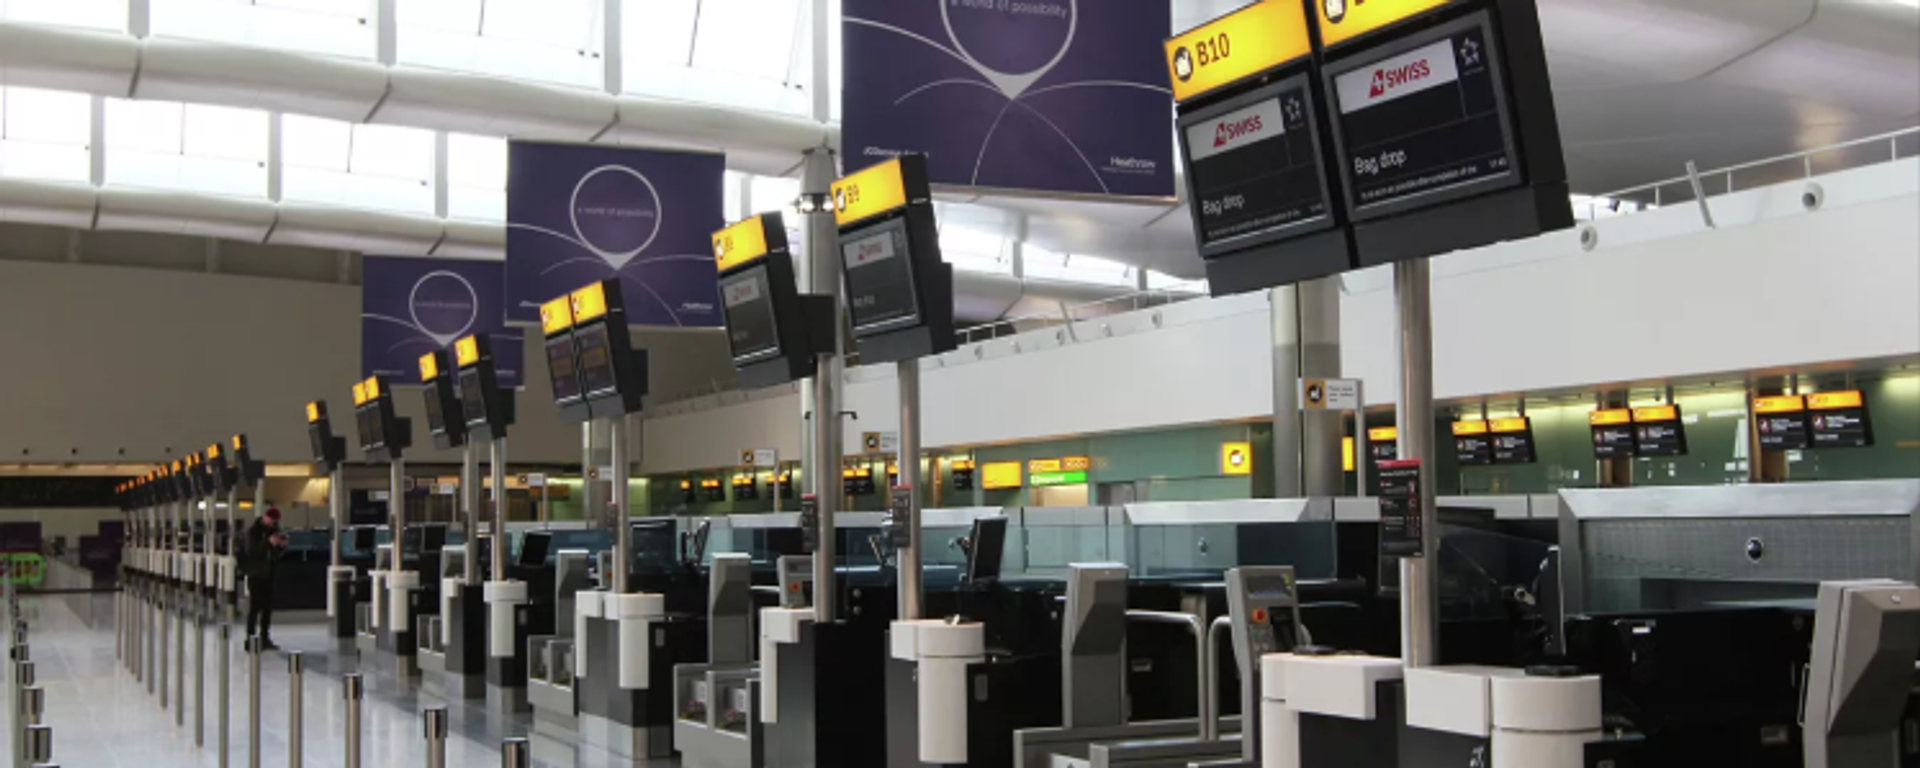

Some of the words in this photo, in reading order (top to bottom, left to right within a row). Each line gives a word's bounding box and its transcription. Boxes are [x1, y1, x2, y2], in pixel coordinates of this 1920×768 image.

[1010, 1, 1067, 19] possibility
[1195, 33, 1230, 66] B10
[1385, 58, 1431, 88] SWISS
[1226, 115, 1263, 140] SWISS
[1354, 156, 1379, 175] Bag
[1379, 150, 1407, 168] drop
